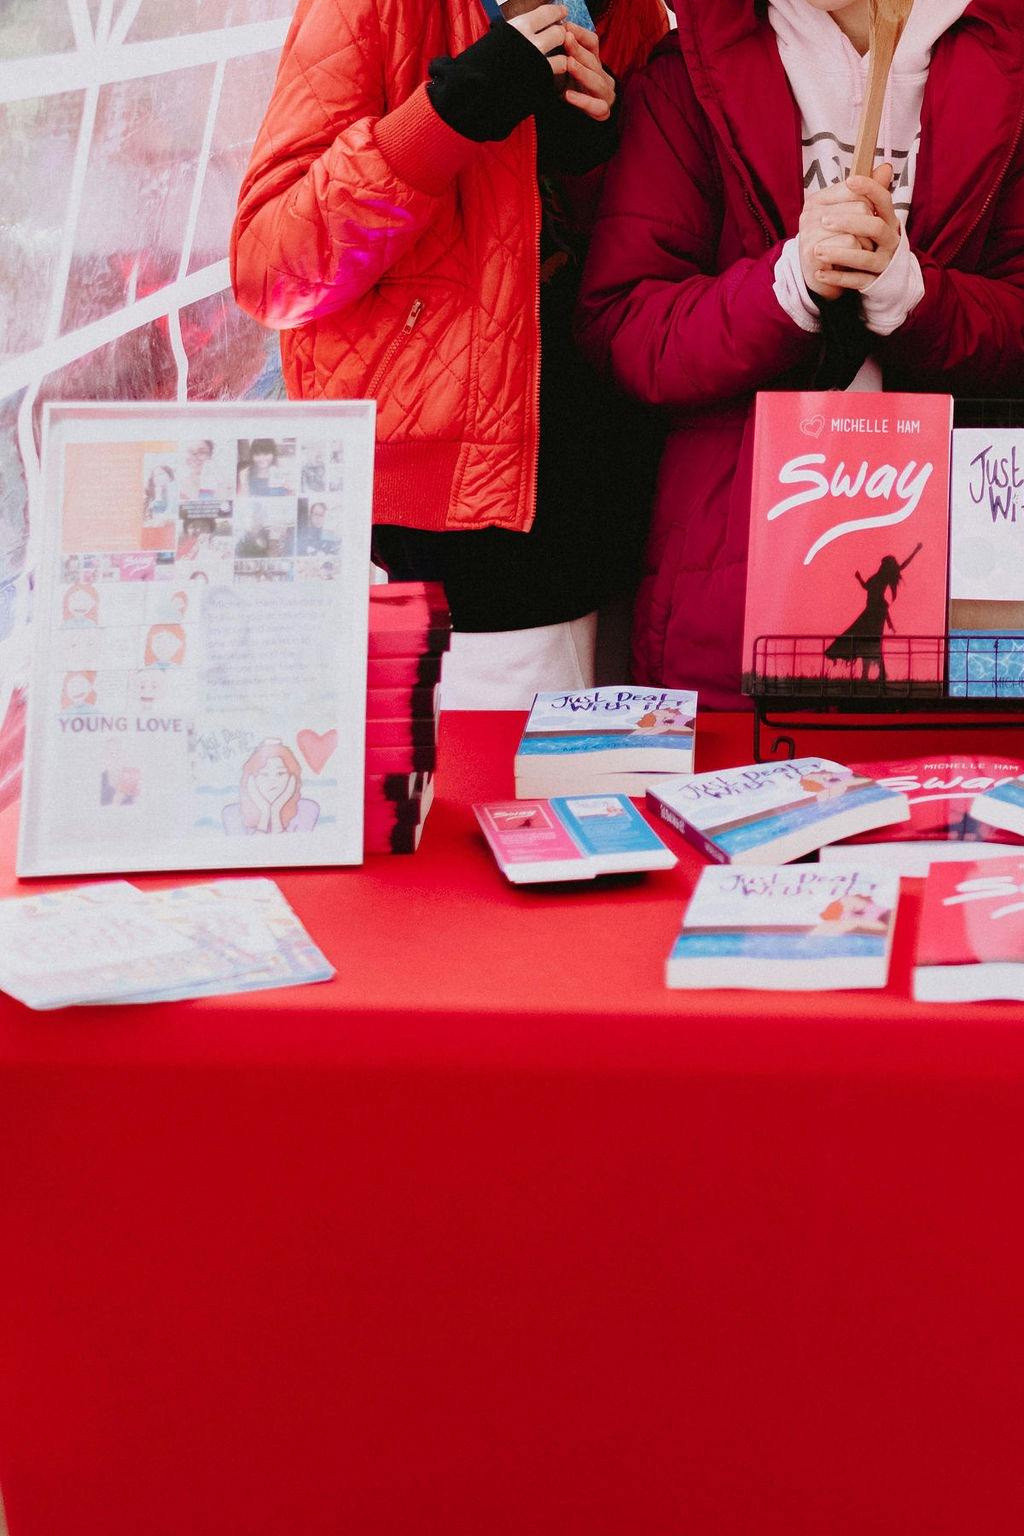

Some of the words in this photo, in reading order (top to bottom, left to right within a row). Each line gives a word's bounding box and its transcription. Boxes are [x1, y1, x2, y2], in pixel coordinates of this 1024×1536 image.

[831, 419, 888, 434] MICHELLE
[897, 419, 920, 434] HAM
[767, 453, 933, 565] Sway
[551, 692, 606, 708] Just
[570, 699, 631, 712] With
[58, 715, 128, 733] YOUNG
[136, 715, 183, 733] LOVE
[924, 763, 986, 771] MICHELLE
[993, 764, 1019, 772] HAM
